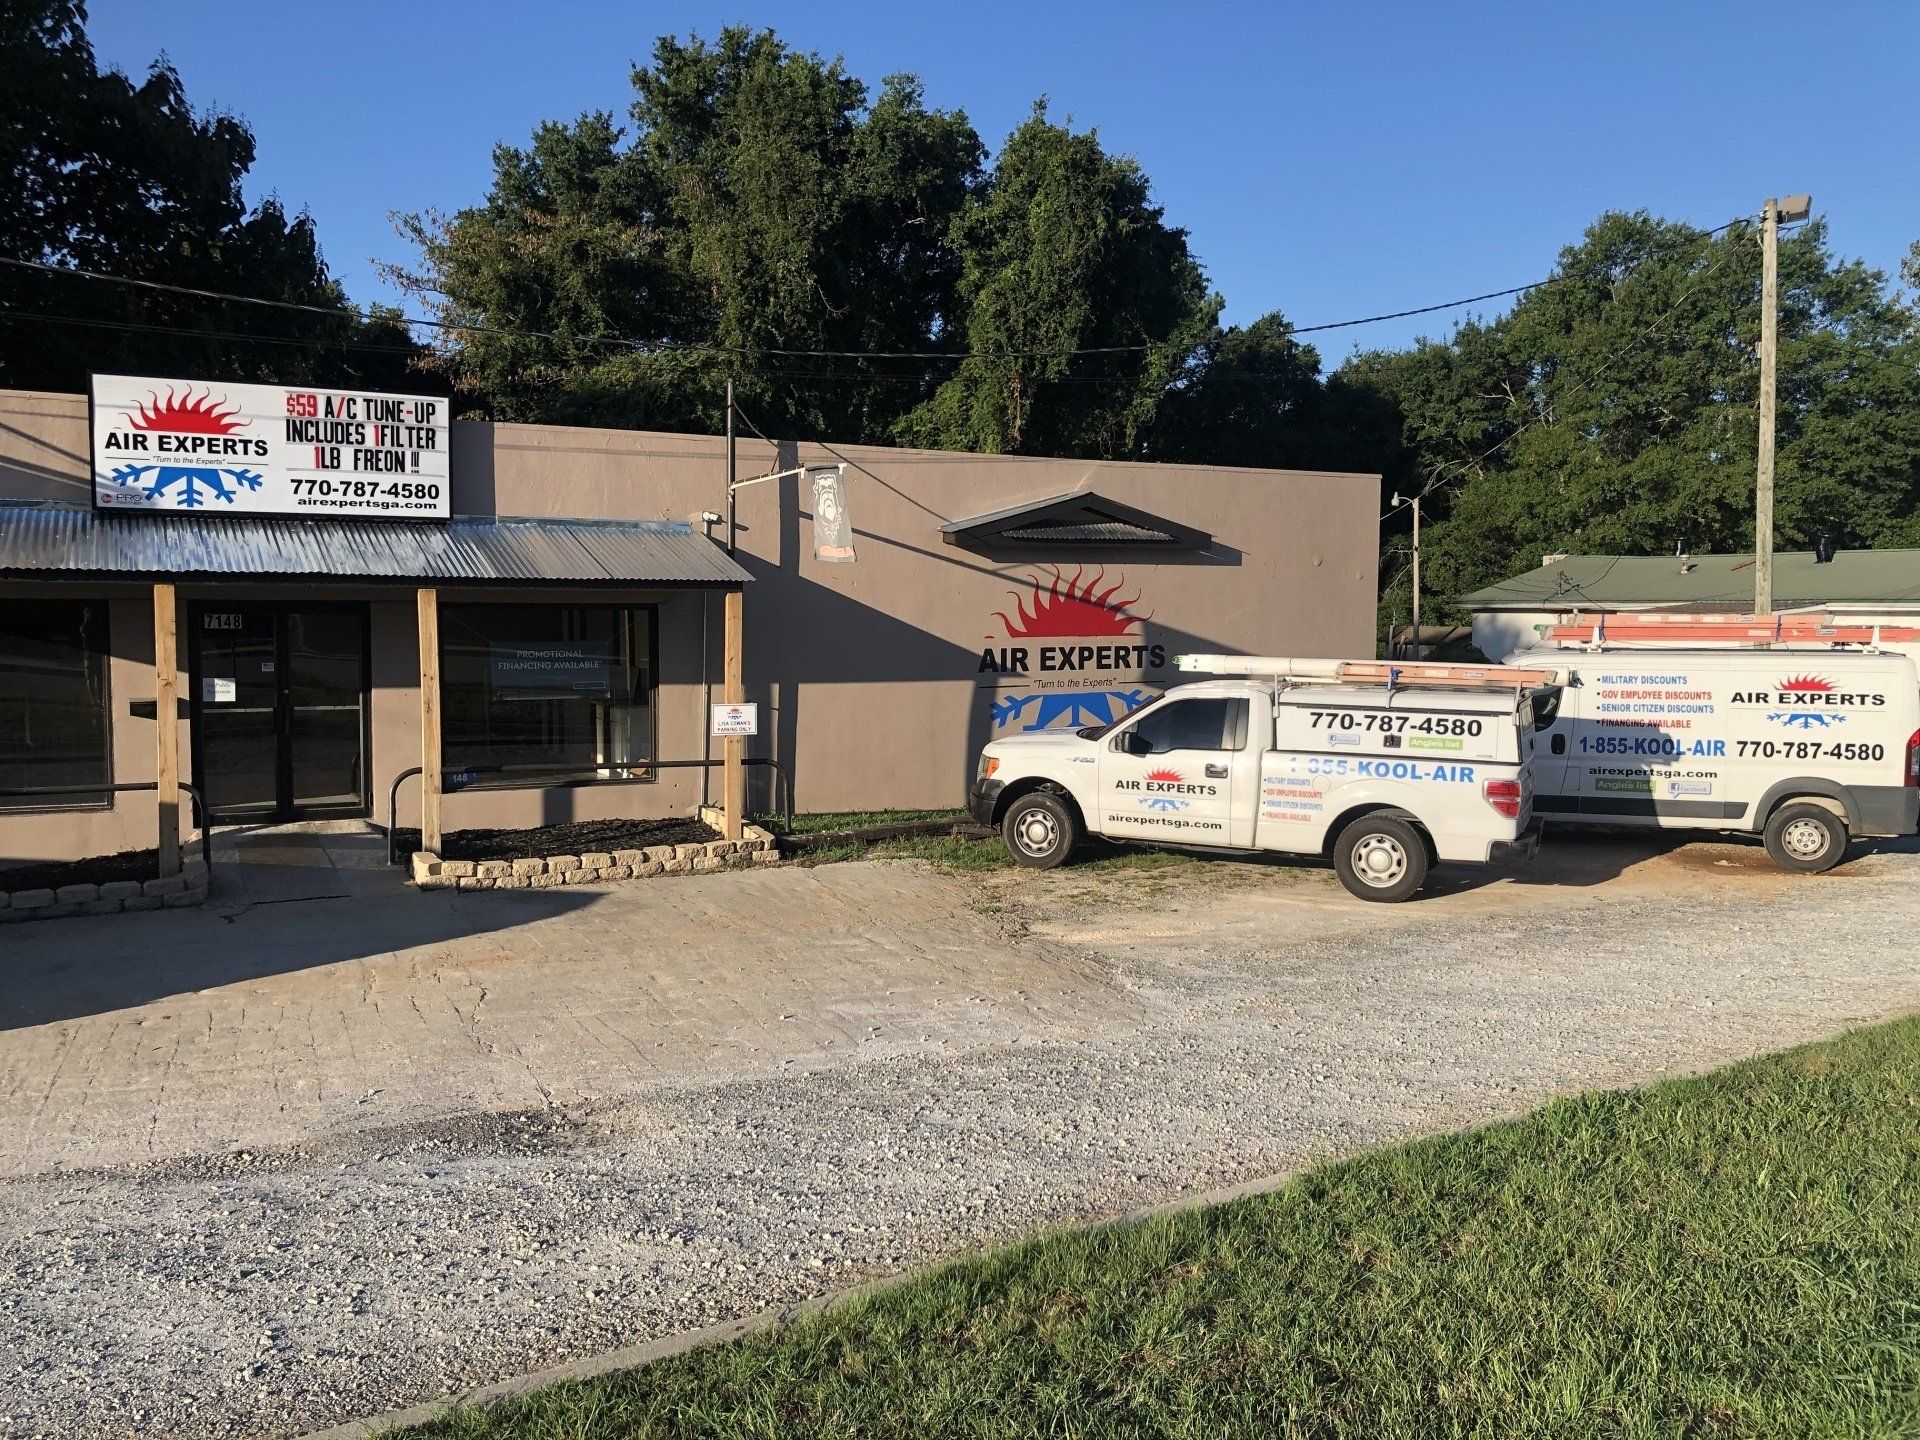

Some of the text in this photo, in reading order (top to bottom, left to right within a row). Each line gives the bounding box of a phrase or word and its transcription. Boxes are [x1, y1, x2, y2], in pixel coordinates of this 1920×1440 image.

[286, 394, 436, 425] $59 A/C TUNE-UP
[285, 418, 366, 446] INCLUDES
[104, 432, 268, 457] AIR EXPERTS
[353, 448, 406, 473] FREON
[290, 478, 440, 500] 770-787-4580
[116, 493, 142, 502] PRO
[297, 497, 438, 510] airexpertsga.com
[206, 614, 241, 628] 7148
[516, 650, 584, 658] PROMOTIONAL
[977, 644, 1166, 674] AIR EXPERTS
[498, 661, 551, 670] FINANCING
[1057, 680, 1065, 688] to
[1067, 678, 1080, 688] the
[1601, 675, 1688, 685] MILITARY DISCOUNTS
[1601, 690, 1712, 701] GOV EMPLOYEE DISCOUNTS
[1730, 692, 1886, 706] AIR EXPERTS
[1601, 703, 1715, 714] SENIOR CITIZEN DISCOUNTS
[1309, 711, 1483, 738] 770-787-4580
[1601, 718, 1692, 729] FINANCING AVAILABLE
[1579, 736, 1726, 757] 1-855-KOOL-AIR
[1736, 740, 1884, 762] 770-787-4580
[1289, 756, 1475, 784] 1855-KOOL-AIR
[1588, 766, 1718, 779] airexpertsga.com
[1115, 779, 1141, 791] AIR
[1146, 781, 1217, 796] EXPERTS
[1108, 813, 1223, 830] airexpertsga.com
